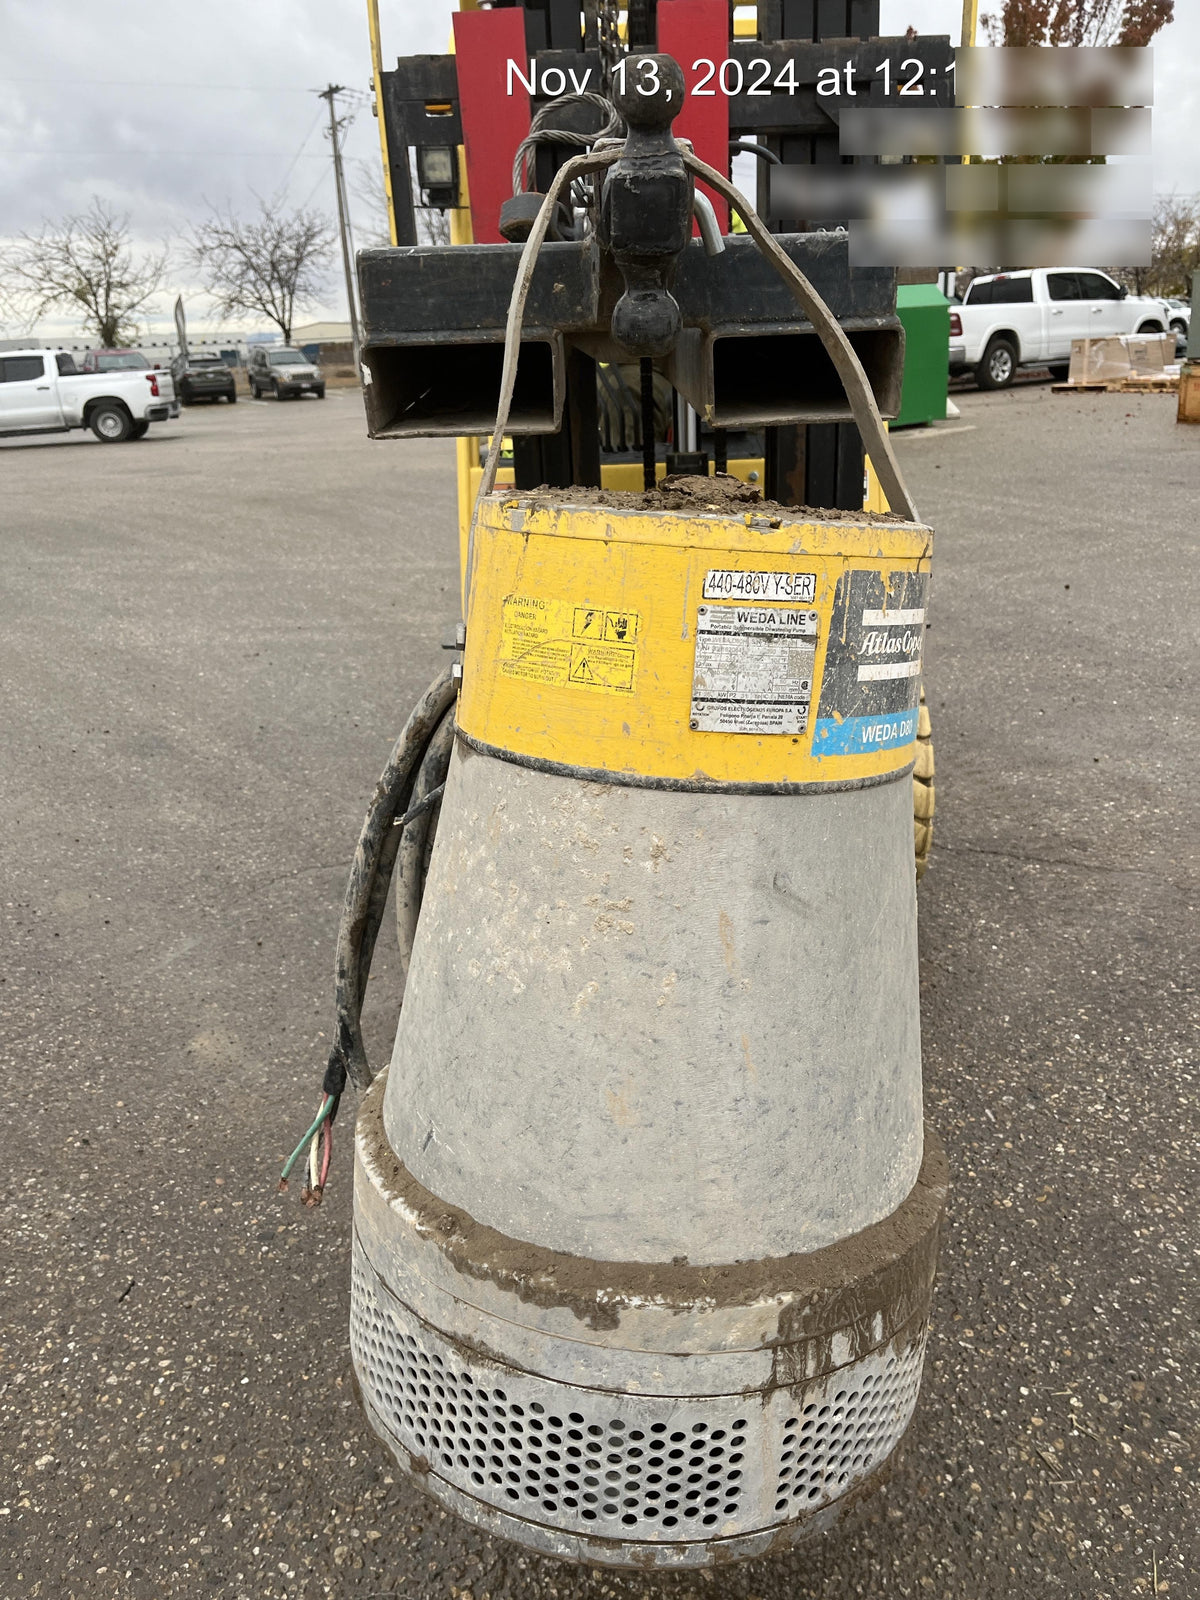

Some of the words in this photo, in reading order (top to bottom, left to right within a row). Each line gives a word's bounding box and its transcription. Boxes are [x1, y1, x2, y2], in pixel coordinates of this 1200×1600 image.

[708, 573, 770, 595] 440-480V
[773, 575, 811, 596] Y-SER
[737, 611, 776, 625] WEDA
[779, 613, 807, 626] LINE
[857, 631, 902, 656] Atlas
[862, 722, 898, 743] WEDA
[899, 719, 913, 738] D80
